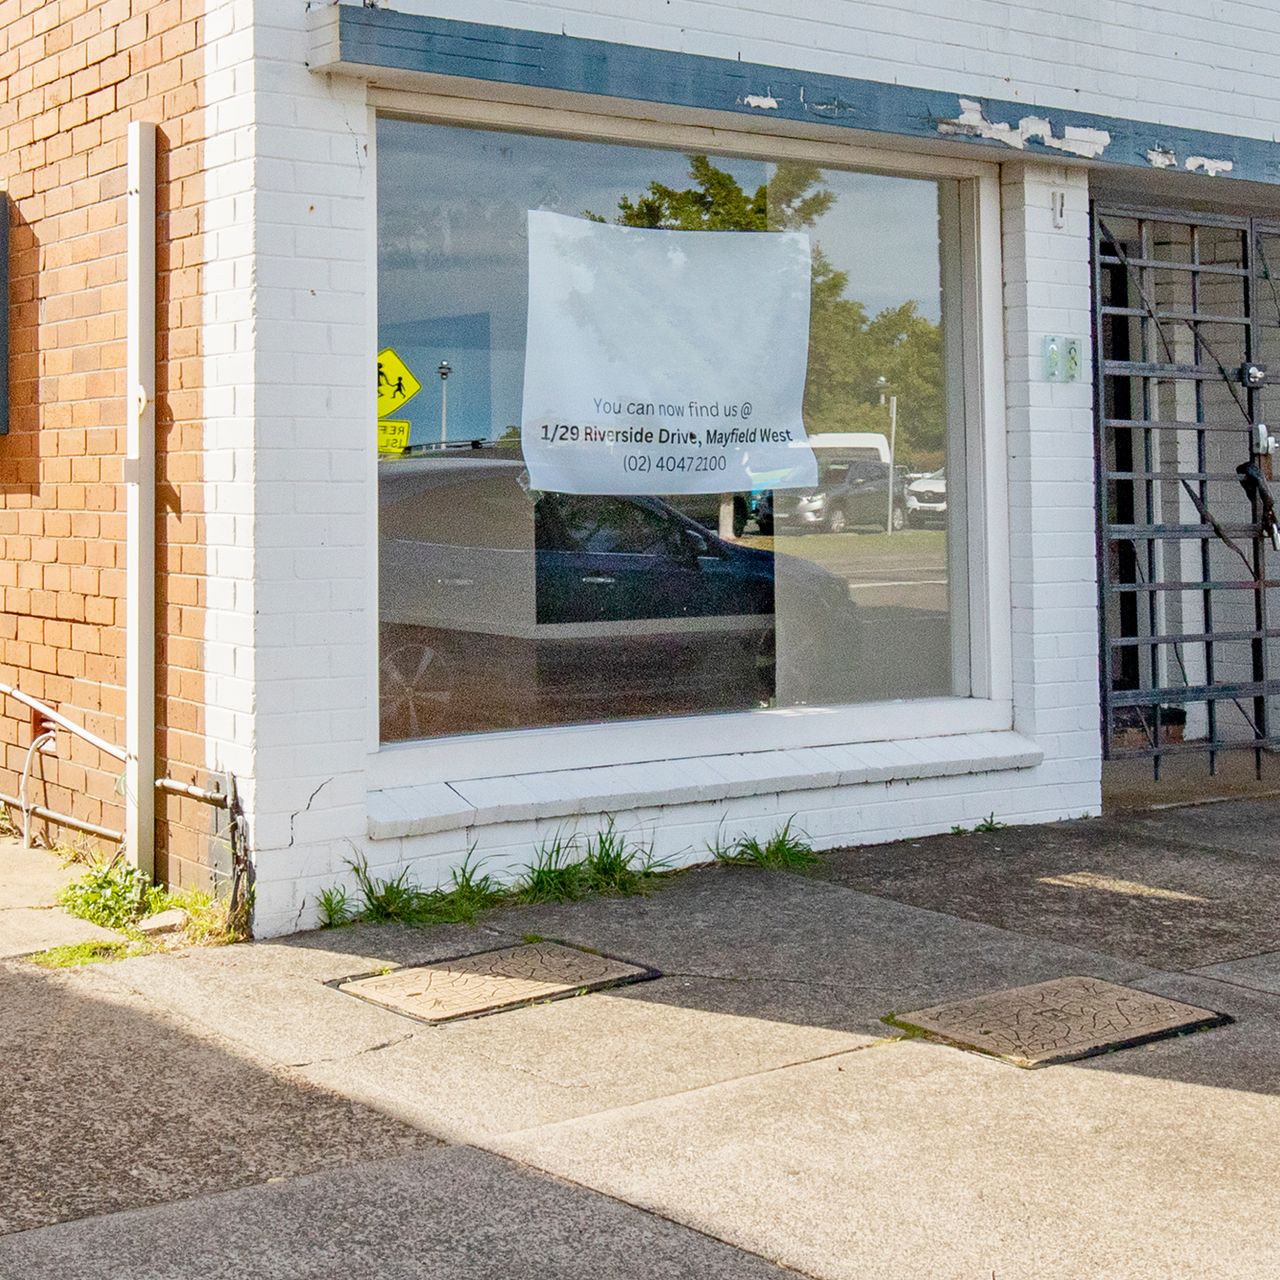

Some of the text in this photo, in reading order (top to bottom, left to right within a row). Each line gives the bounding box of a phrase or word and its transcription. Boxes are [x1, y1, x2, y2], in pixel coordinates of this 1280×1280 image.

[593, 397, 753, 420] You can now find us @
[540, 424, 794, 448] 1/29 Riverside Drive, Mayfield West
[623, 455, 652, 473] (02)
